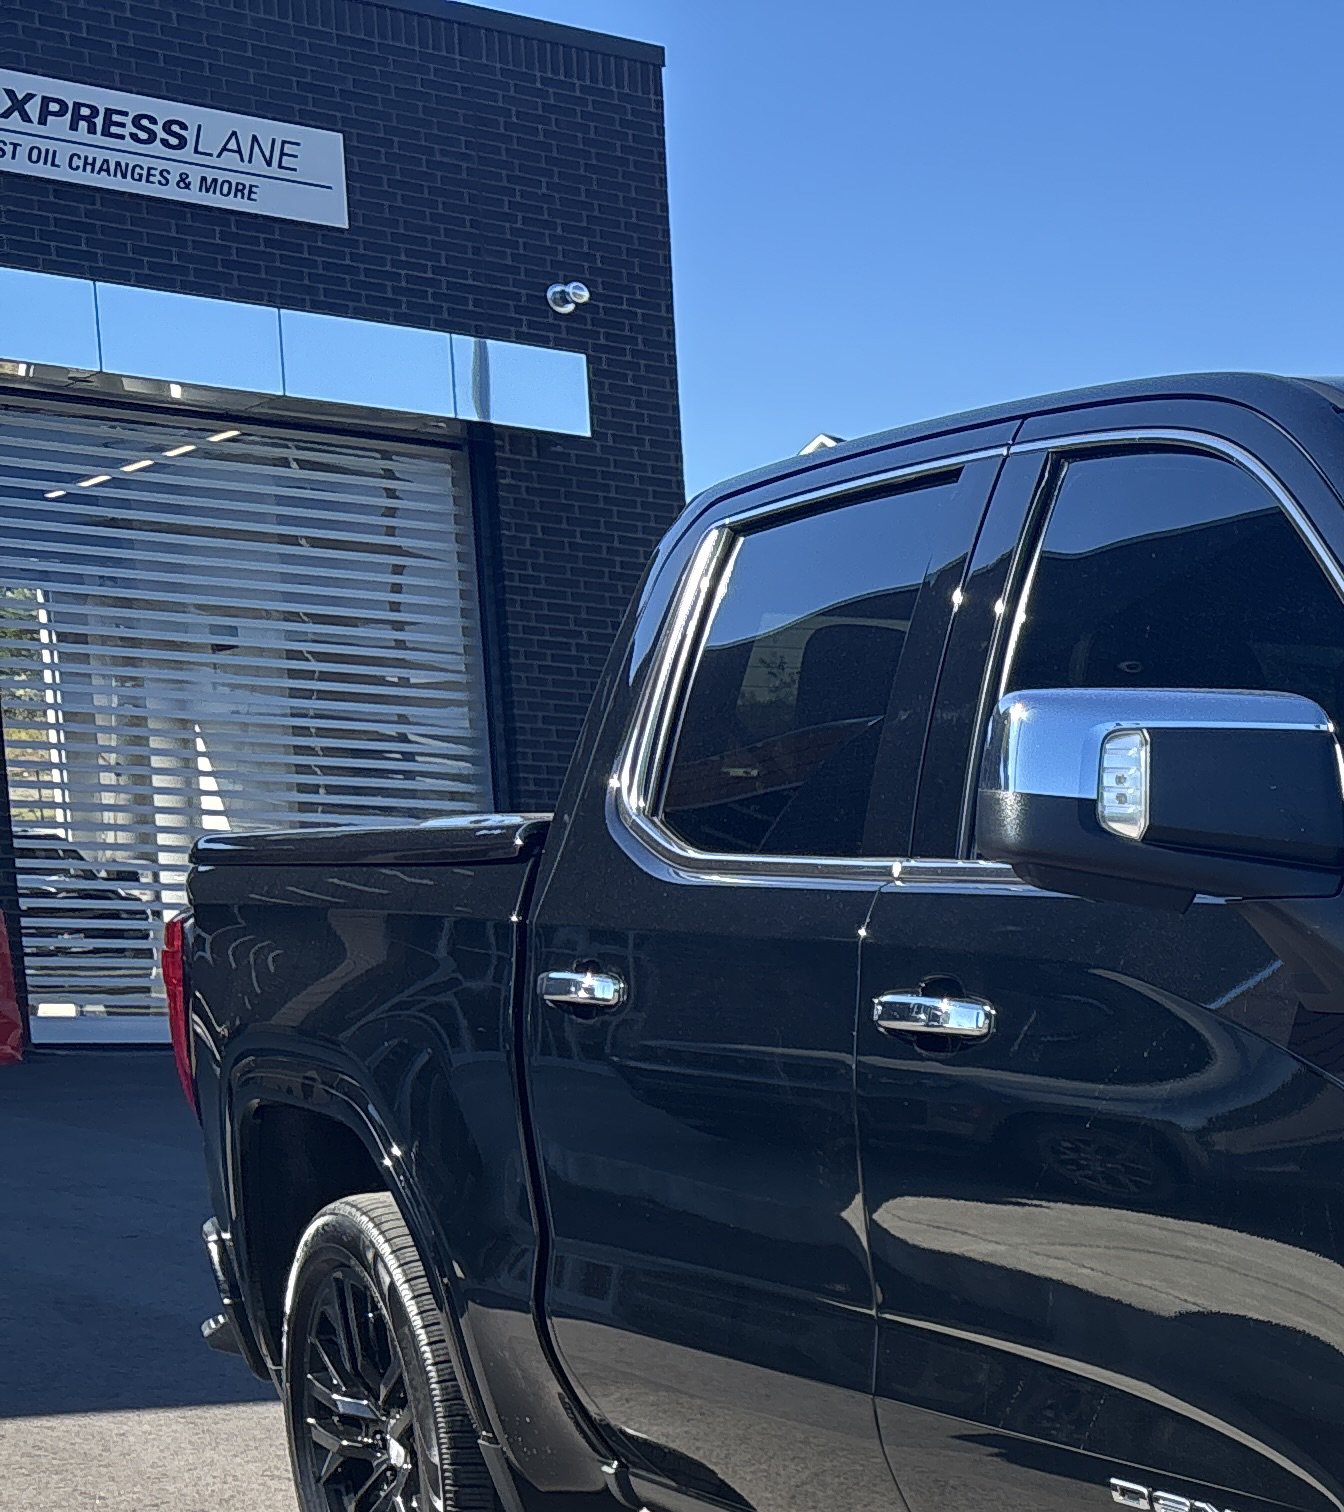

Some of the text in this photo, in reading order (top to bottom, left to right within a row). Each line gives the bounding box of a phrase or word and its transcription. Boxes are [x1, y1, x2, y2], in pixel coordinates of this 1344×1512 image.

[27, 145, 61, 168] OIL
[68, 152, 170, 187] CHANGES
[176, 172, 192, 191] &
[199, 175, 260, 202] MORE
